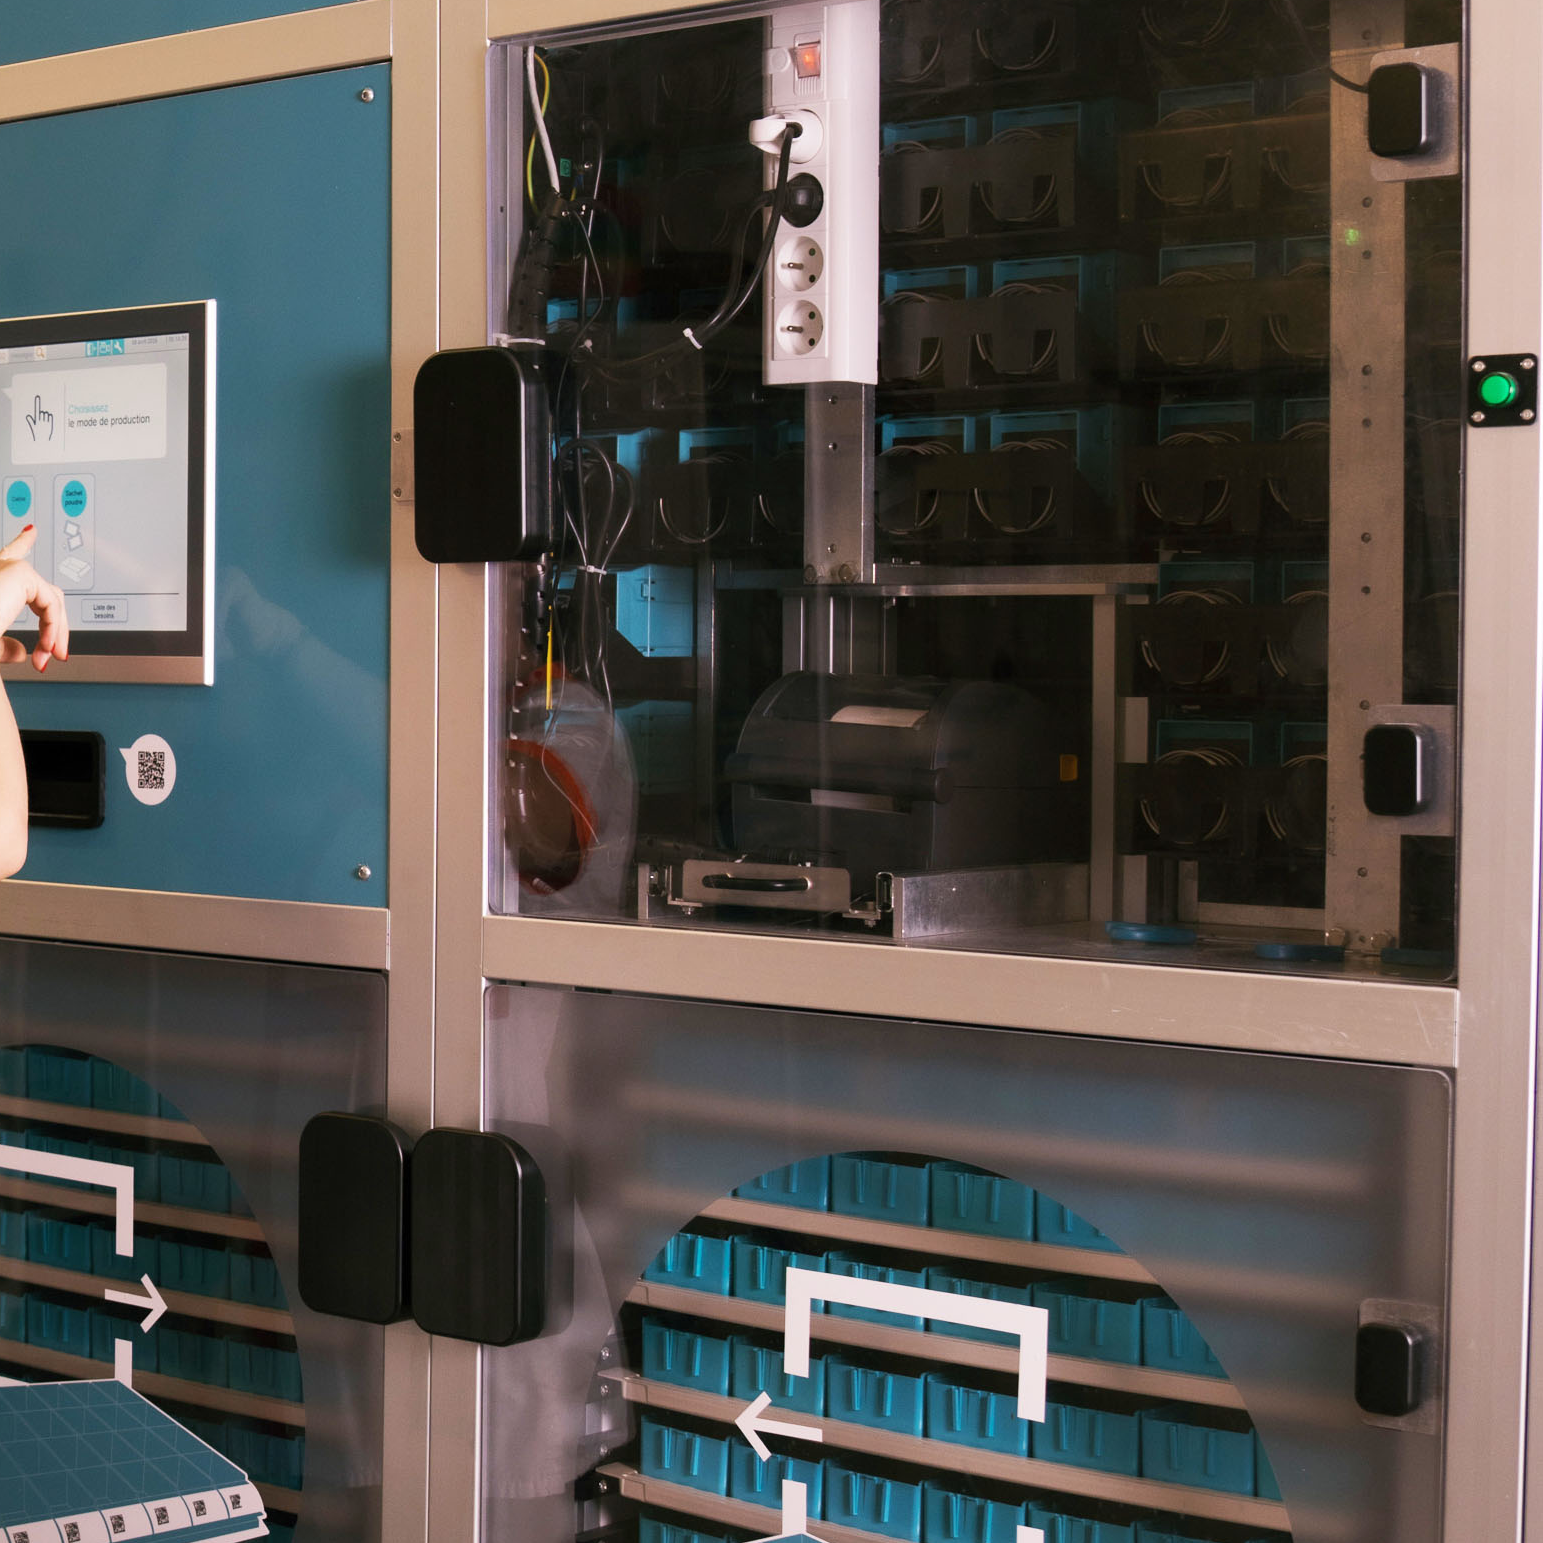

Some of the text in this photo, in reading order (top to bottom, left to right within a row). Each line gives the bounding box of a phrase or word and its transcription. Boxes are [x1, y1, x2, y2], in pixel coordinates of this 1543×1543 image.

[67, 414, 150, 428] le mode de production
